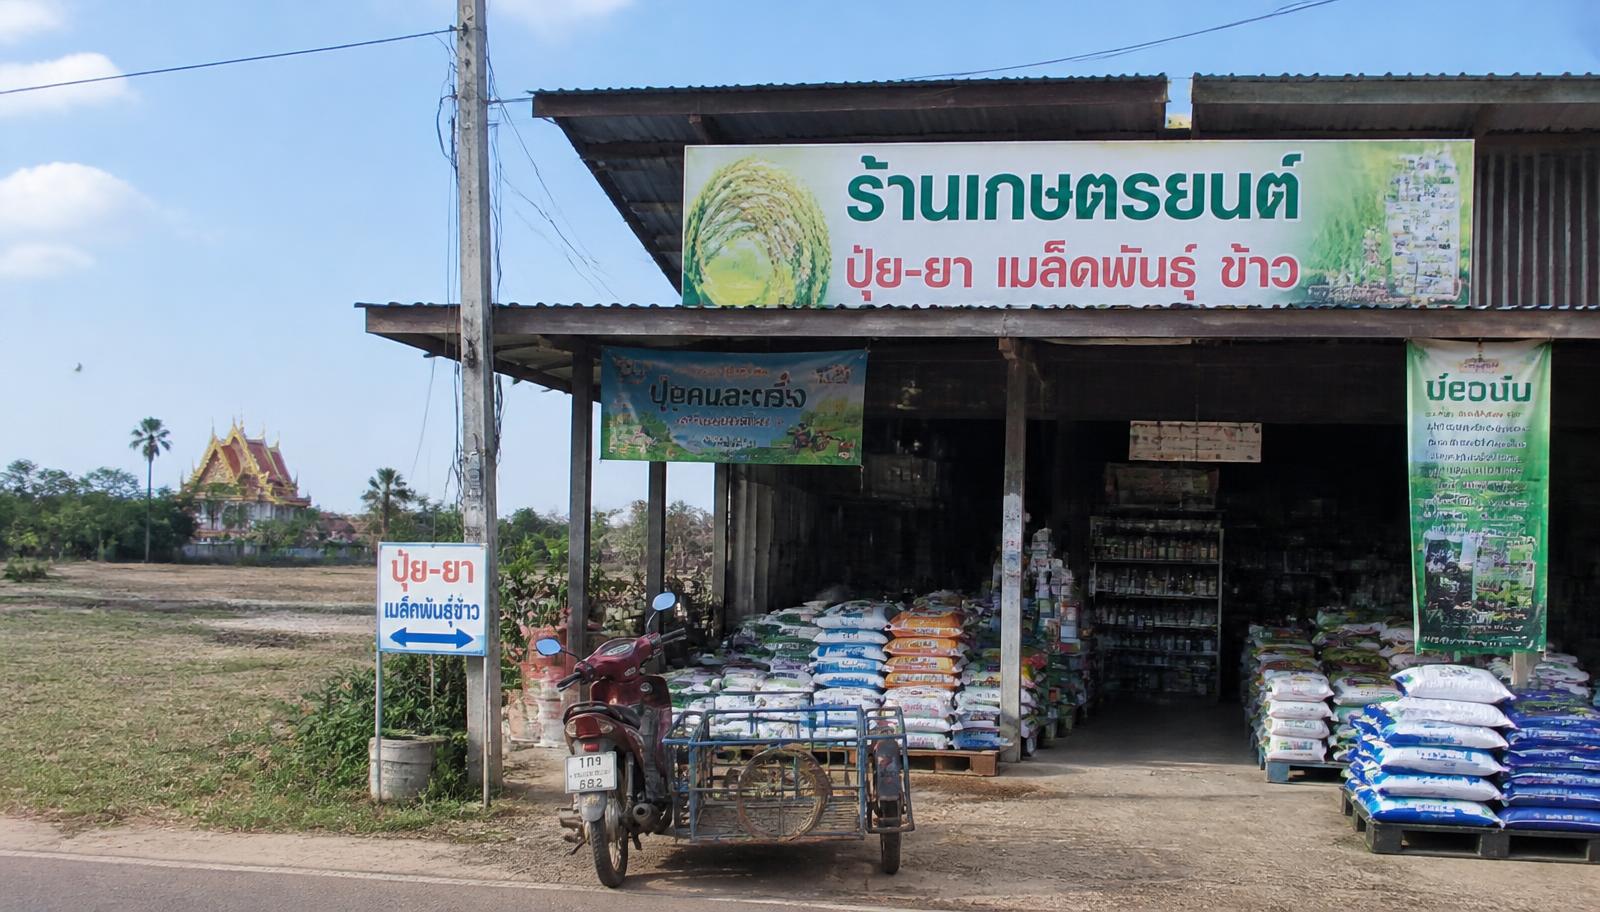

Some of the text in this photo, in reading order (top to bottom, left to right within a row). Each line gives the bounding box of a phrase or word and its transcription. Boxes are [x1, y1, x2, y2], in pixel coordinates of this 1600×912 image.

[847, 154, 1301, 222] ร้านเกษตรยนต์
[998, 240, 1196, 302] เมล็ดพันธุ์
[1221, 243, 1299, 288] ข้าว
